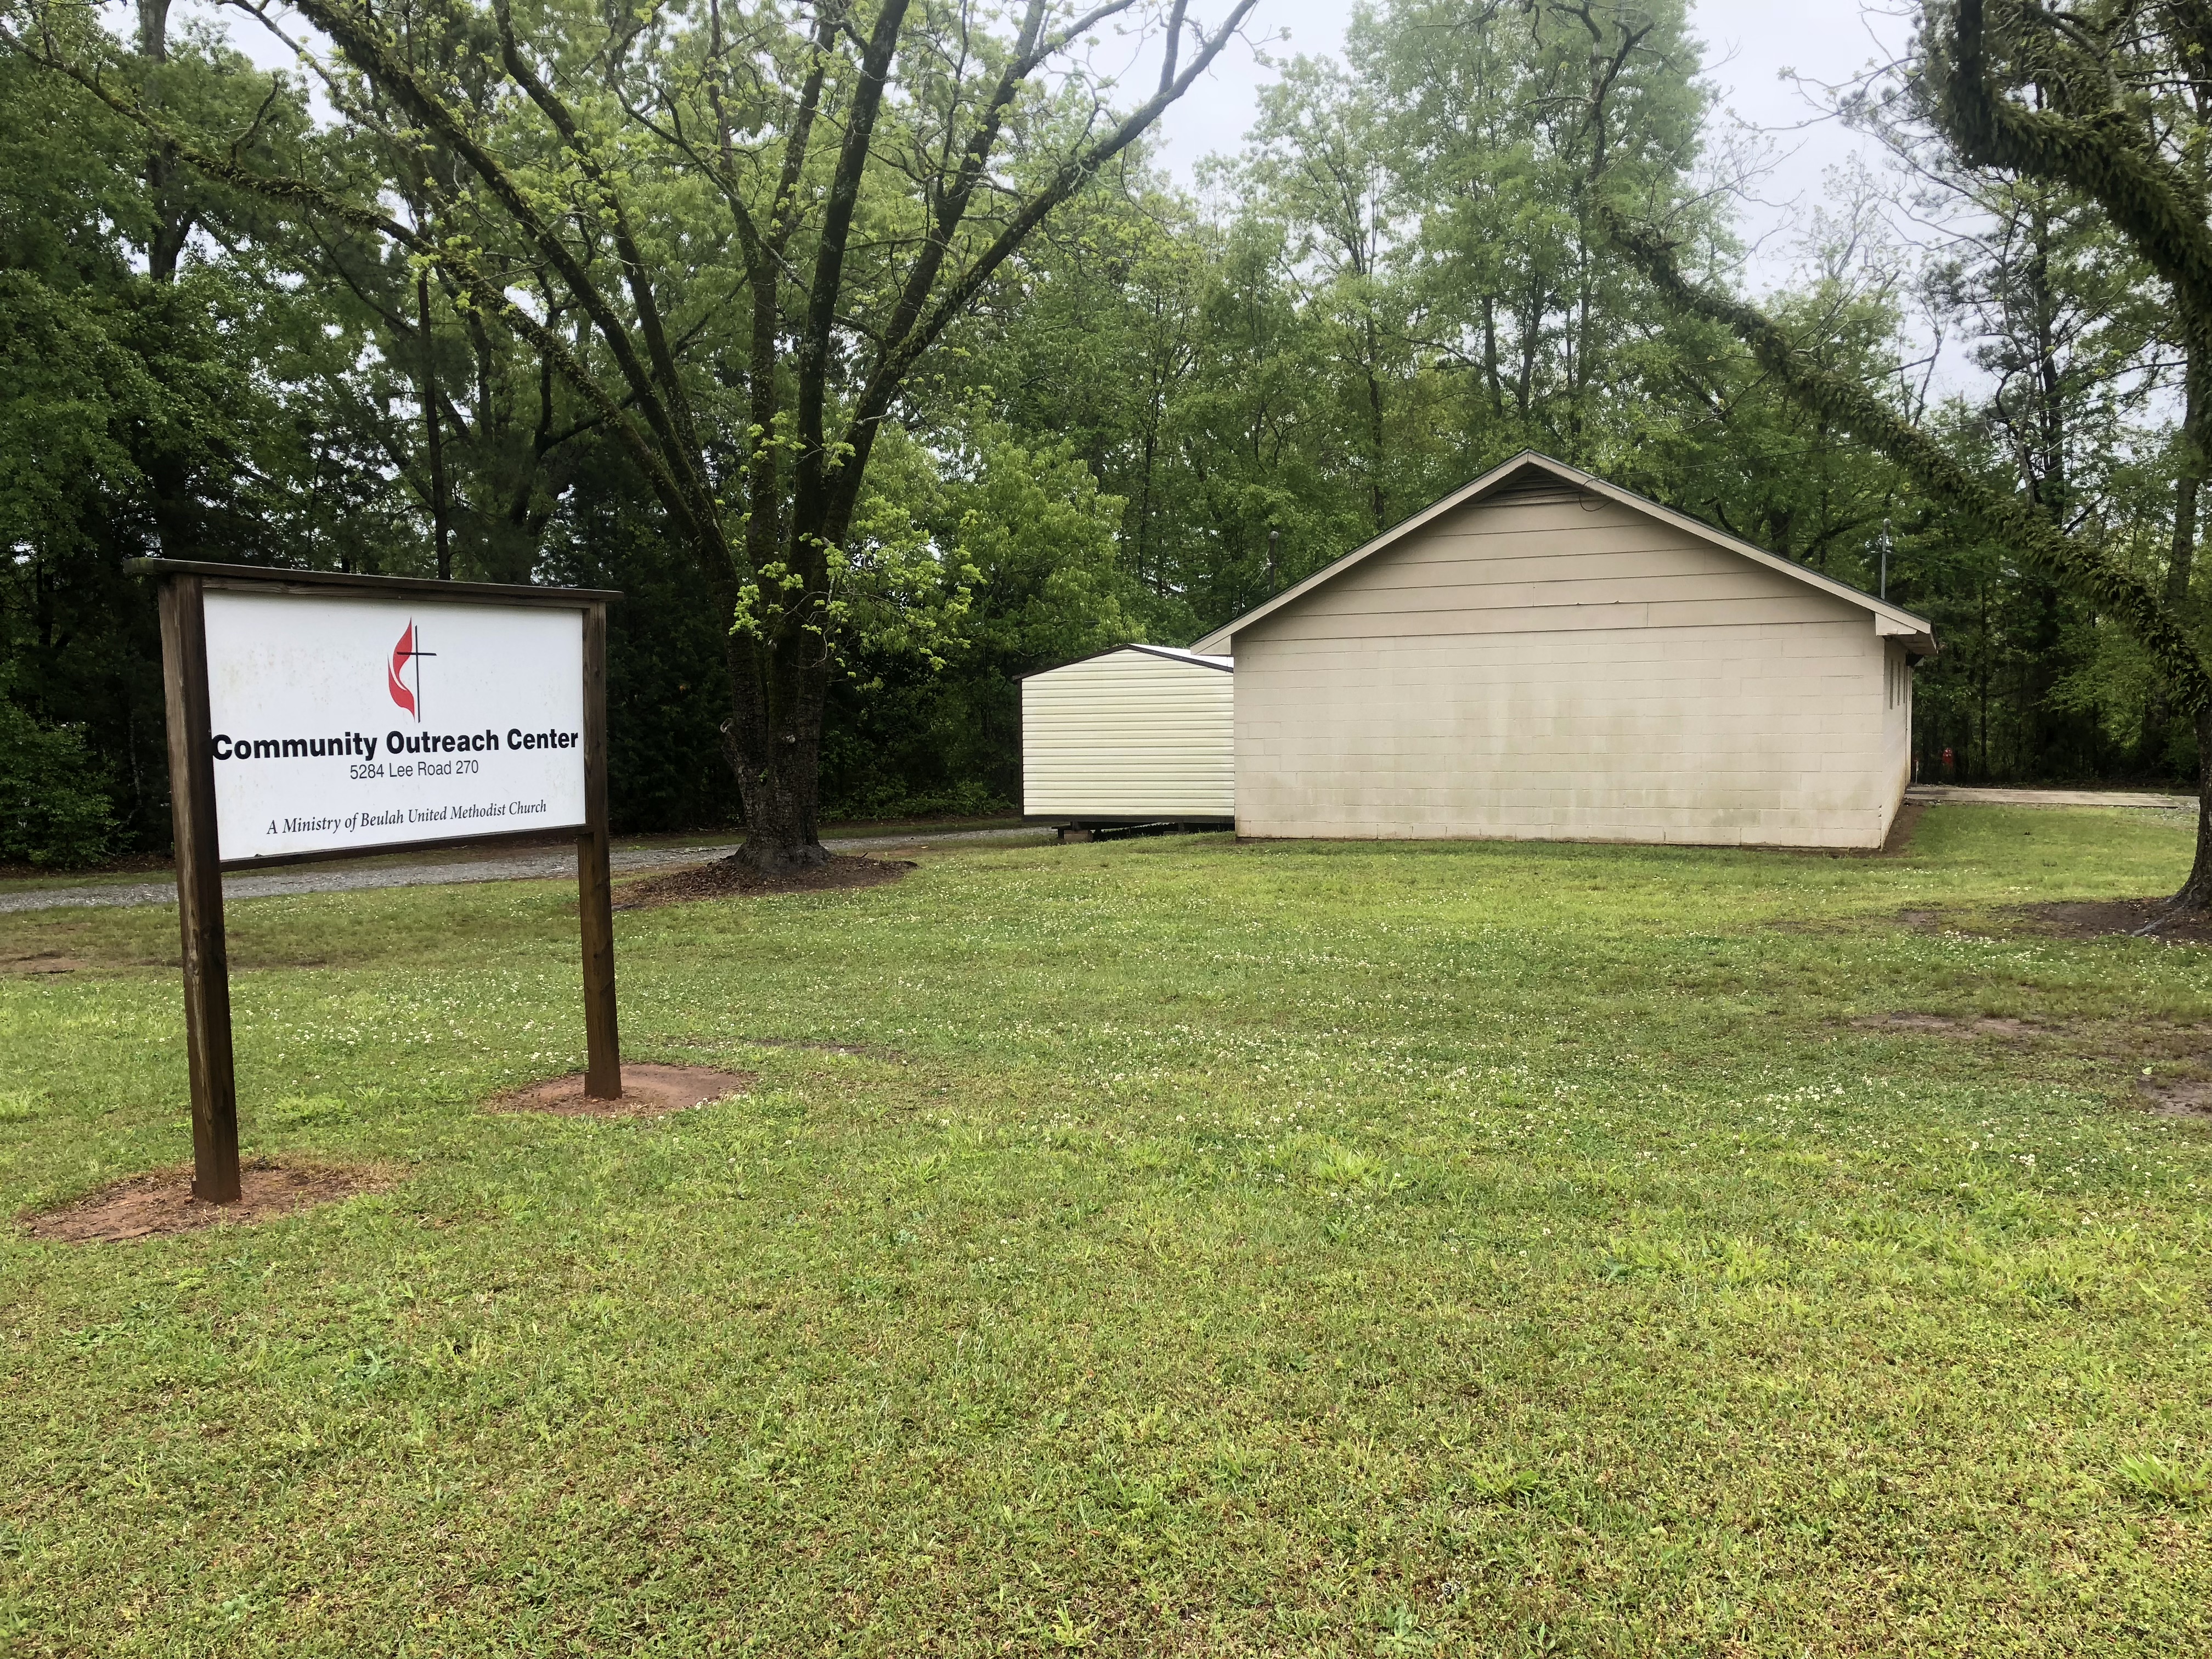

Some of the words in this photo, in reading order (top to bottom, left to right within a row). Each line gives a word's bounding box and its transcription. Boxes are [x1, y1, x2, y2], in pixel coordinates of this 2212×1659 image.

[212, 731, 378, 762] Community
[386, 729, 499, 754] Outreach
[507, 728, 579, 751] Center
[350, 764, 385, 780] 5284
[389, 762, 413, 777] Lee
[417, 761, 452, 776] Road
[456, 759, 479, 774] 270
[266, 820, 278, 834] A
[282, 817, 341, 834] Ministry
[345, 812, 359, 831] of
[360, 809, 404, 827] Beulah
[408, 808, 448, 823] United
[450, 803, 506, 820] Methodist
[509, 799, 547, 815] Church
